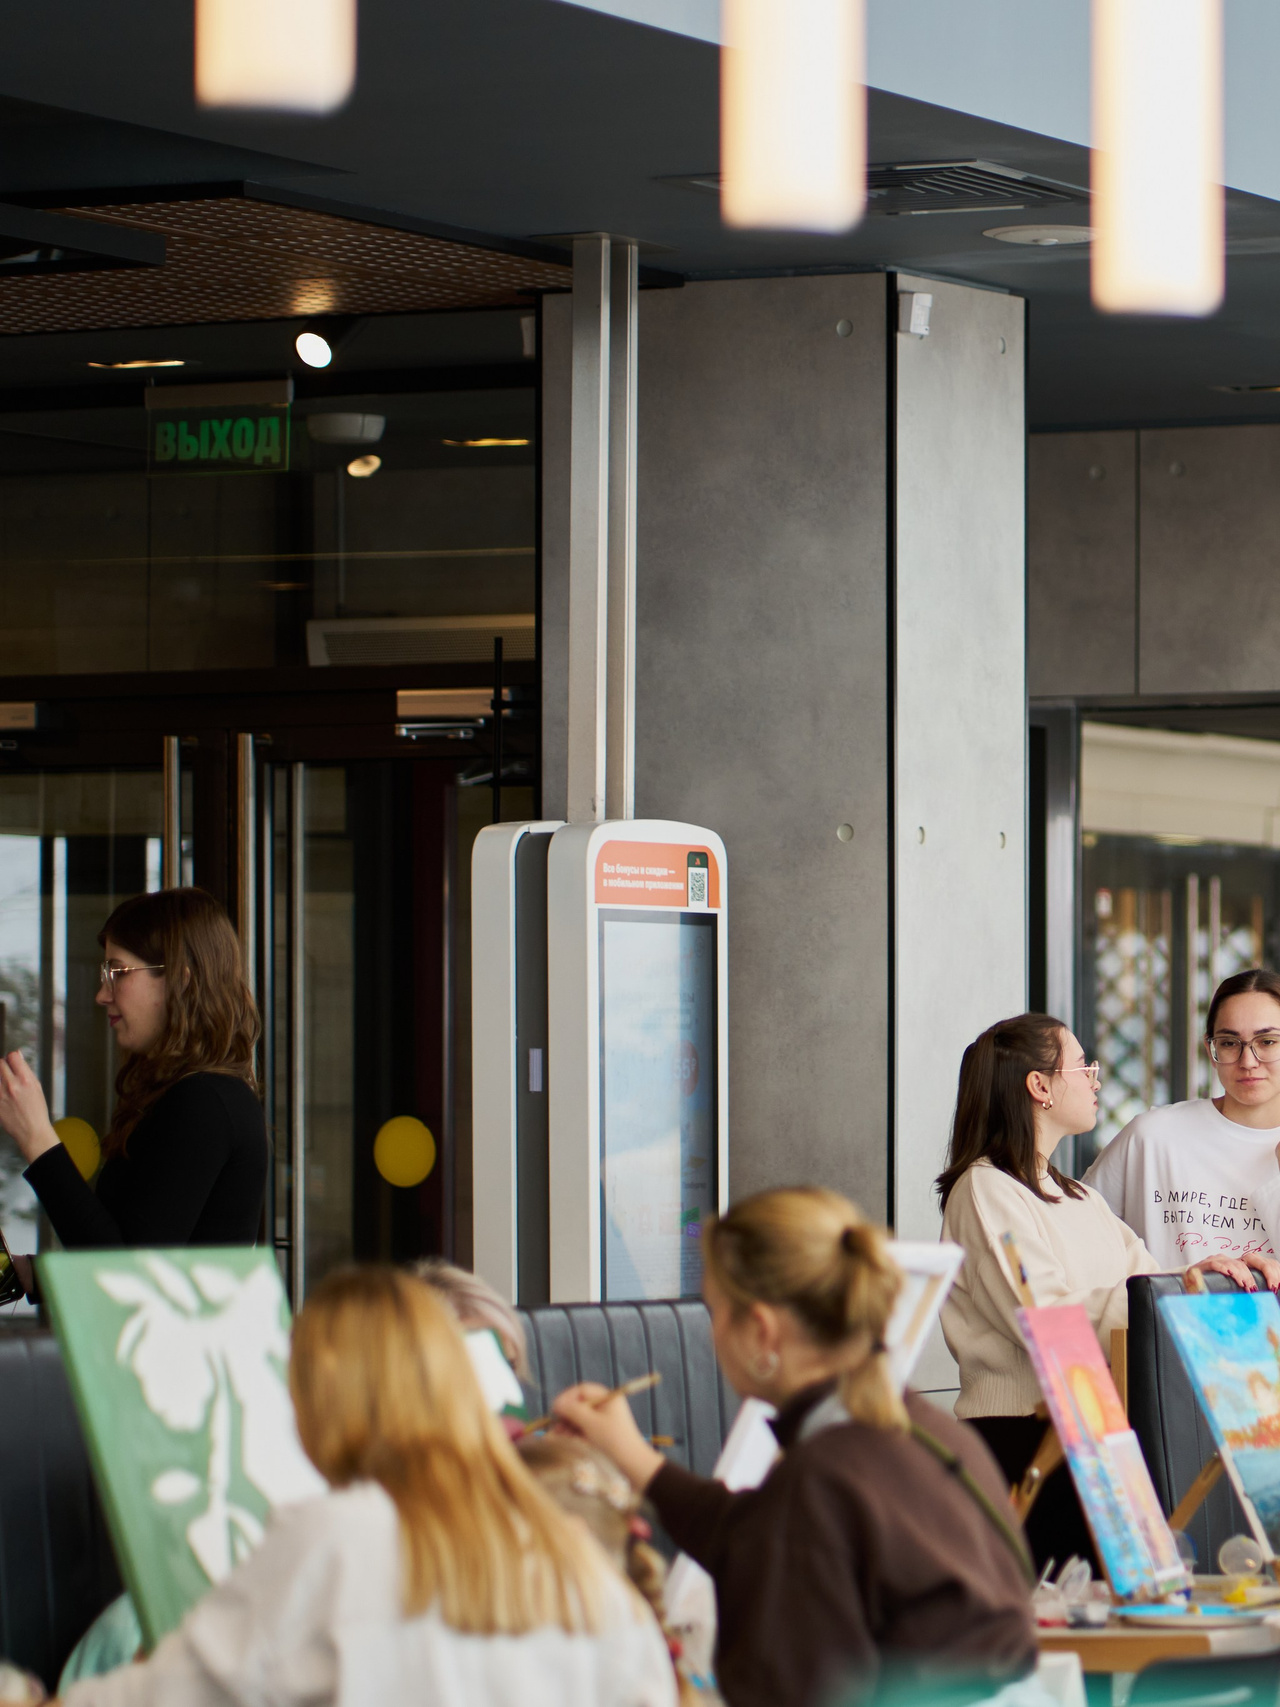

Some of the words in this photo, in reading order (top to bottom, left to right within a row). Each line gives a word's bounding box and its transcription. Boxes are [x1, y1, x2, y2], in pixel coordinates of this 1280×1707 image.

[155, 416, 282, 465] ВЫХОД
[603, 862, 615, 874] Все
[1154, 1190, 1163, 1203] В
[1168, 1190, 1211, 1208] МИРЕ,
[1219, 1195, 1249, 1211] ГДЕ
[1163, 1209, 1194, 1224] БЫТЬ
[1202, 1213, 1235, 1230] КЕМ
[1175, 1232, 1208, 1253] будь
